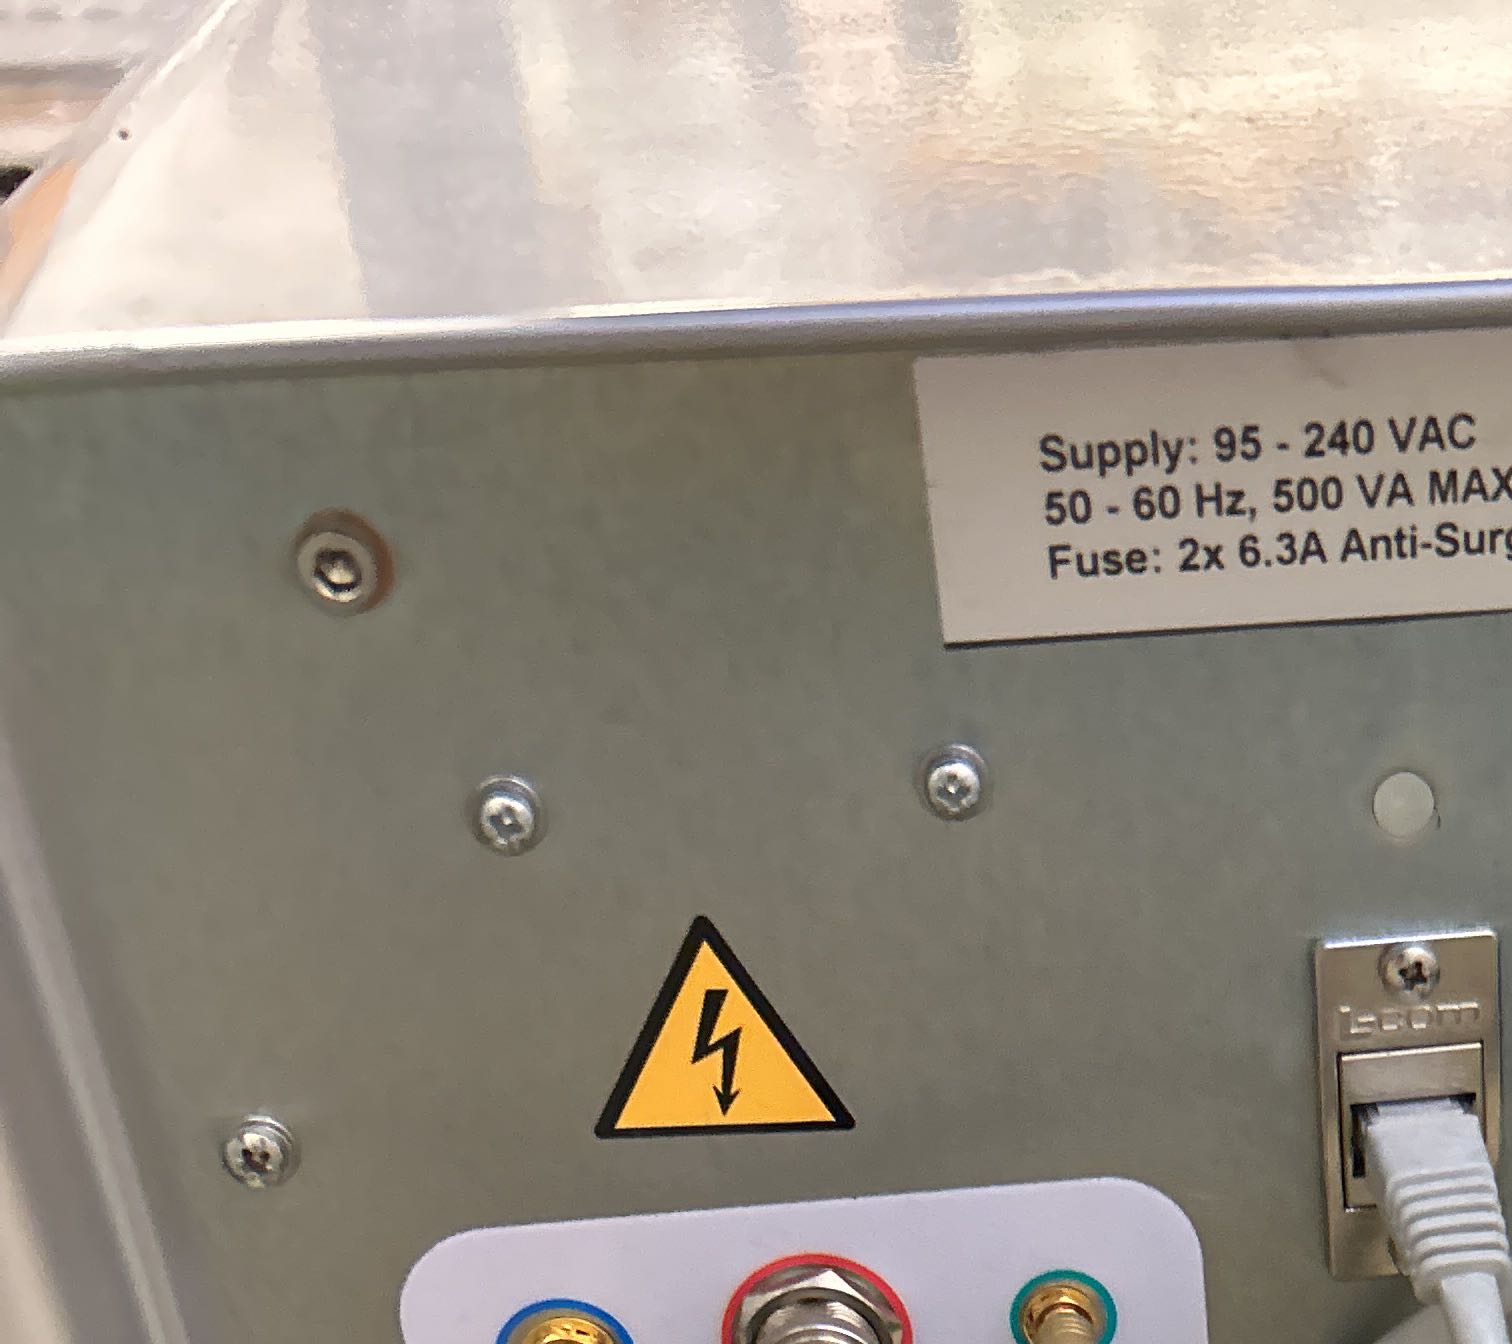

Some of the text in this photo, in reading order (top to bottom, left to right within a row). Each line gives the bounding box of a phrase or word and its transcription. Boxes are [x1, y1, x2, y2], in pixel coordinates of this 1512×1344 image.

[1039, 412, 1477, 478] Supply: 95 - 240 VAC
[1044, 489, 1092, 526] 50
[1107, 505, 1120, 515] -
[1132, 485, 1181, 521] 60
[1195, 481, 1257, 521] Hz,
[1273, 475, 1344, 513] 500
[1355, 472, 1414, 509] VA
[1048, 544, 1161, 580] Fuse:
[1178, 537, 1225, 572] 2x
[1238, 530, 1328, 568] 6.3A
